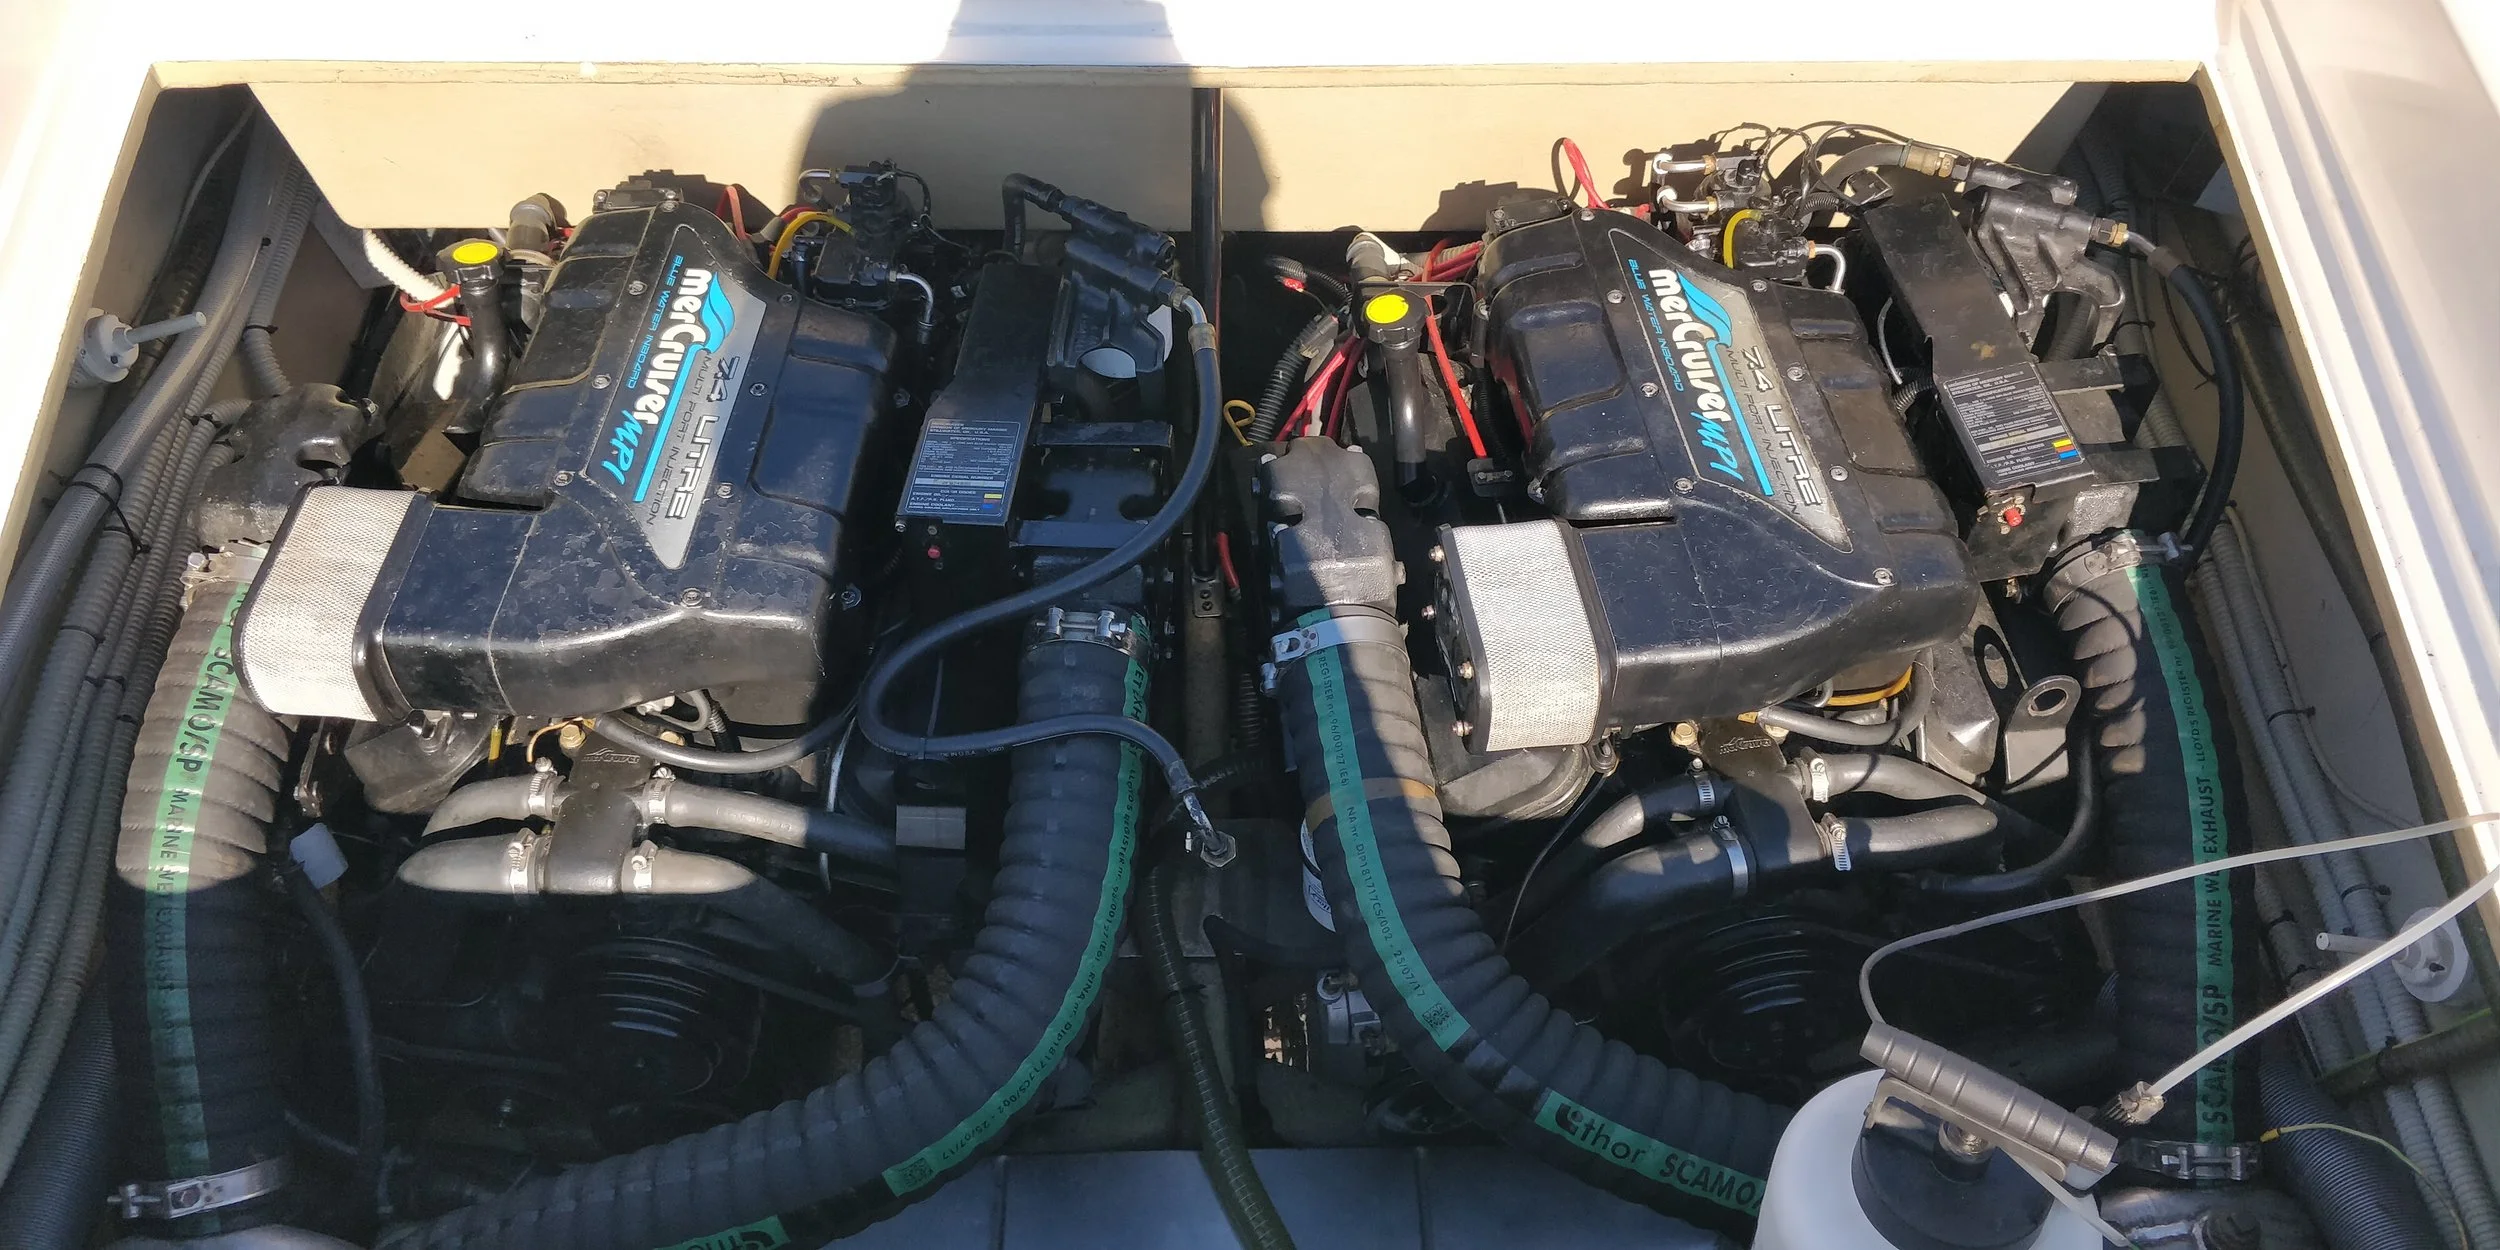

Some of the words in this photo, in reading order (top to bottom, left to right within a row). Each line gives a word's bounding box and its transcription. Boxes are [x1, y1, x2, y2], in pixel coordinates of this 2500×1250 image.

[666, 254, 684, 286] BLUE
[648, 290, 671, 331] WATER
[1628, 258, 1646, 291] BLUE
[1642, 293, 1663, 336] WATER
[1657, 337, 1685, 393] INBOARD
[626, 334, 654, 390] INBOARD
[693, 353, 713, 398] MULTI
[601, 410, 644, 485] MPI
[677, 400, 697, 442] PORT
[1690, 411, 1745, 483] MPI
[1726, 349, 1749, 392] MULTI
[1742, 393, 1769, 435] PORT
[1759, 437, 1801, 516] INJECTION
[1764, 403, 1822, 507] LITRE
[646, 445, 681, 526] INJECTION
[664, 414, 720, 520] LITRE
[175, 645, 235, 772] SCAMO/SP
[2175, 669, 2194, 717] REGISTER
[158, 789, 190, 860] MARINE
[1118, 813, 1136, 867] REGISTER
[1317, 656, 1335, 701] REGISTER
[1330, 717, 1347, 765] 96/00127
[1393, 949, 1427, 998] 25/07/17
[2197, 776, 2219, 854] EXHAUST
[2208, 899, 2223, 967] MARINE
[1580, 1118, 1648, 1164] thor
